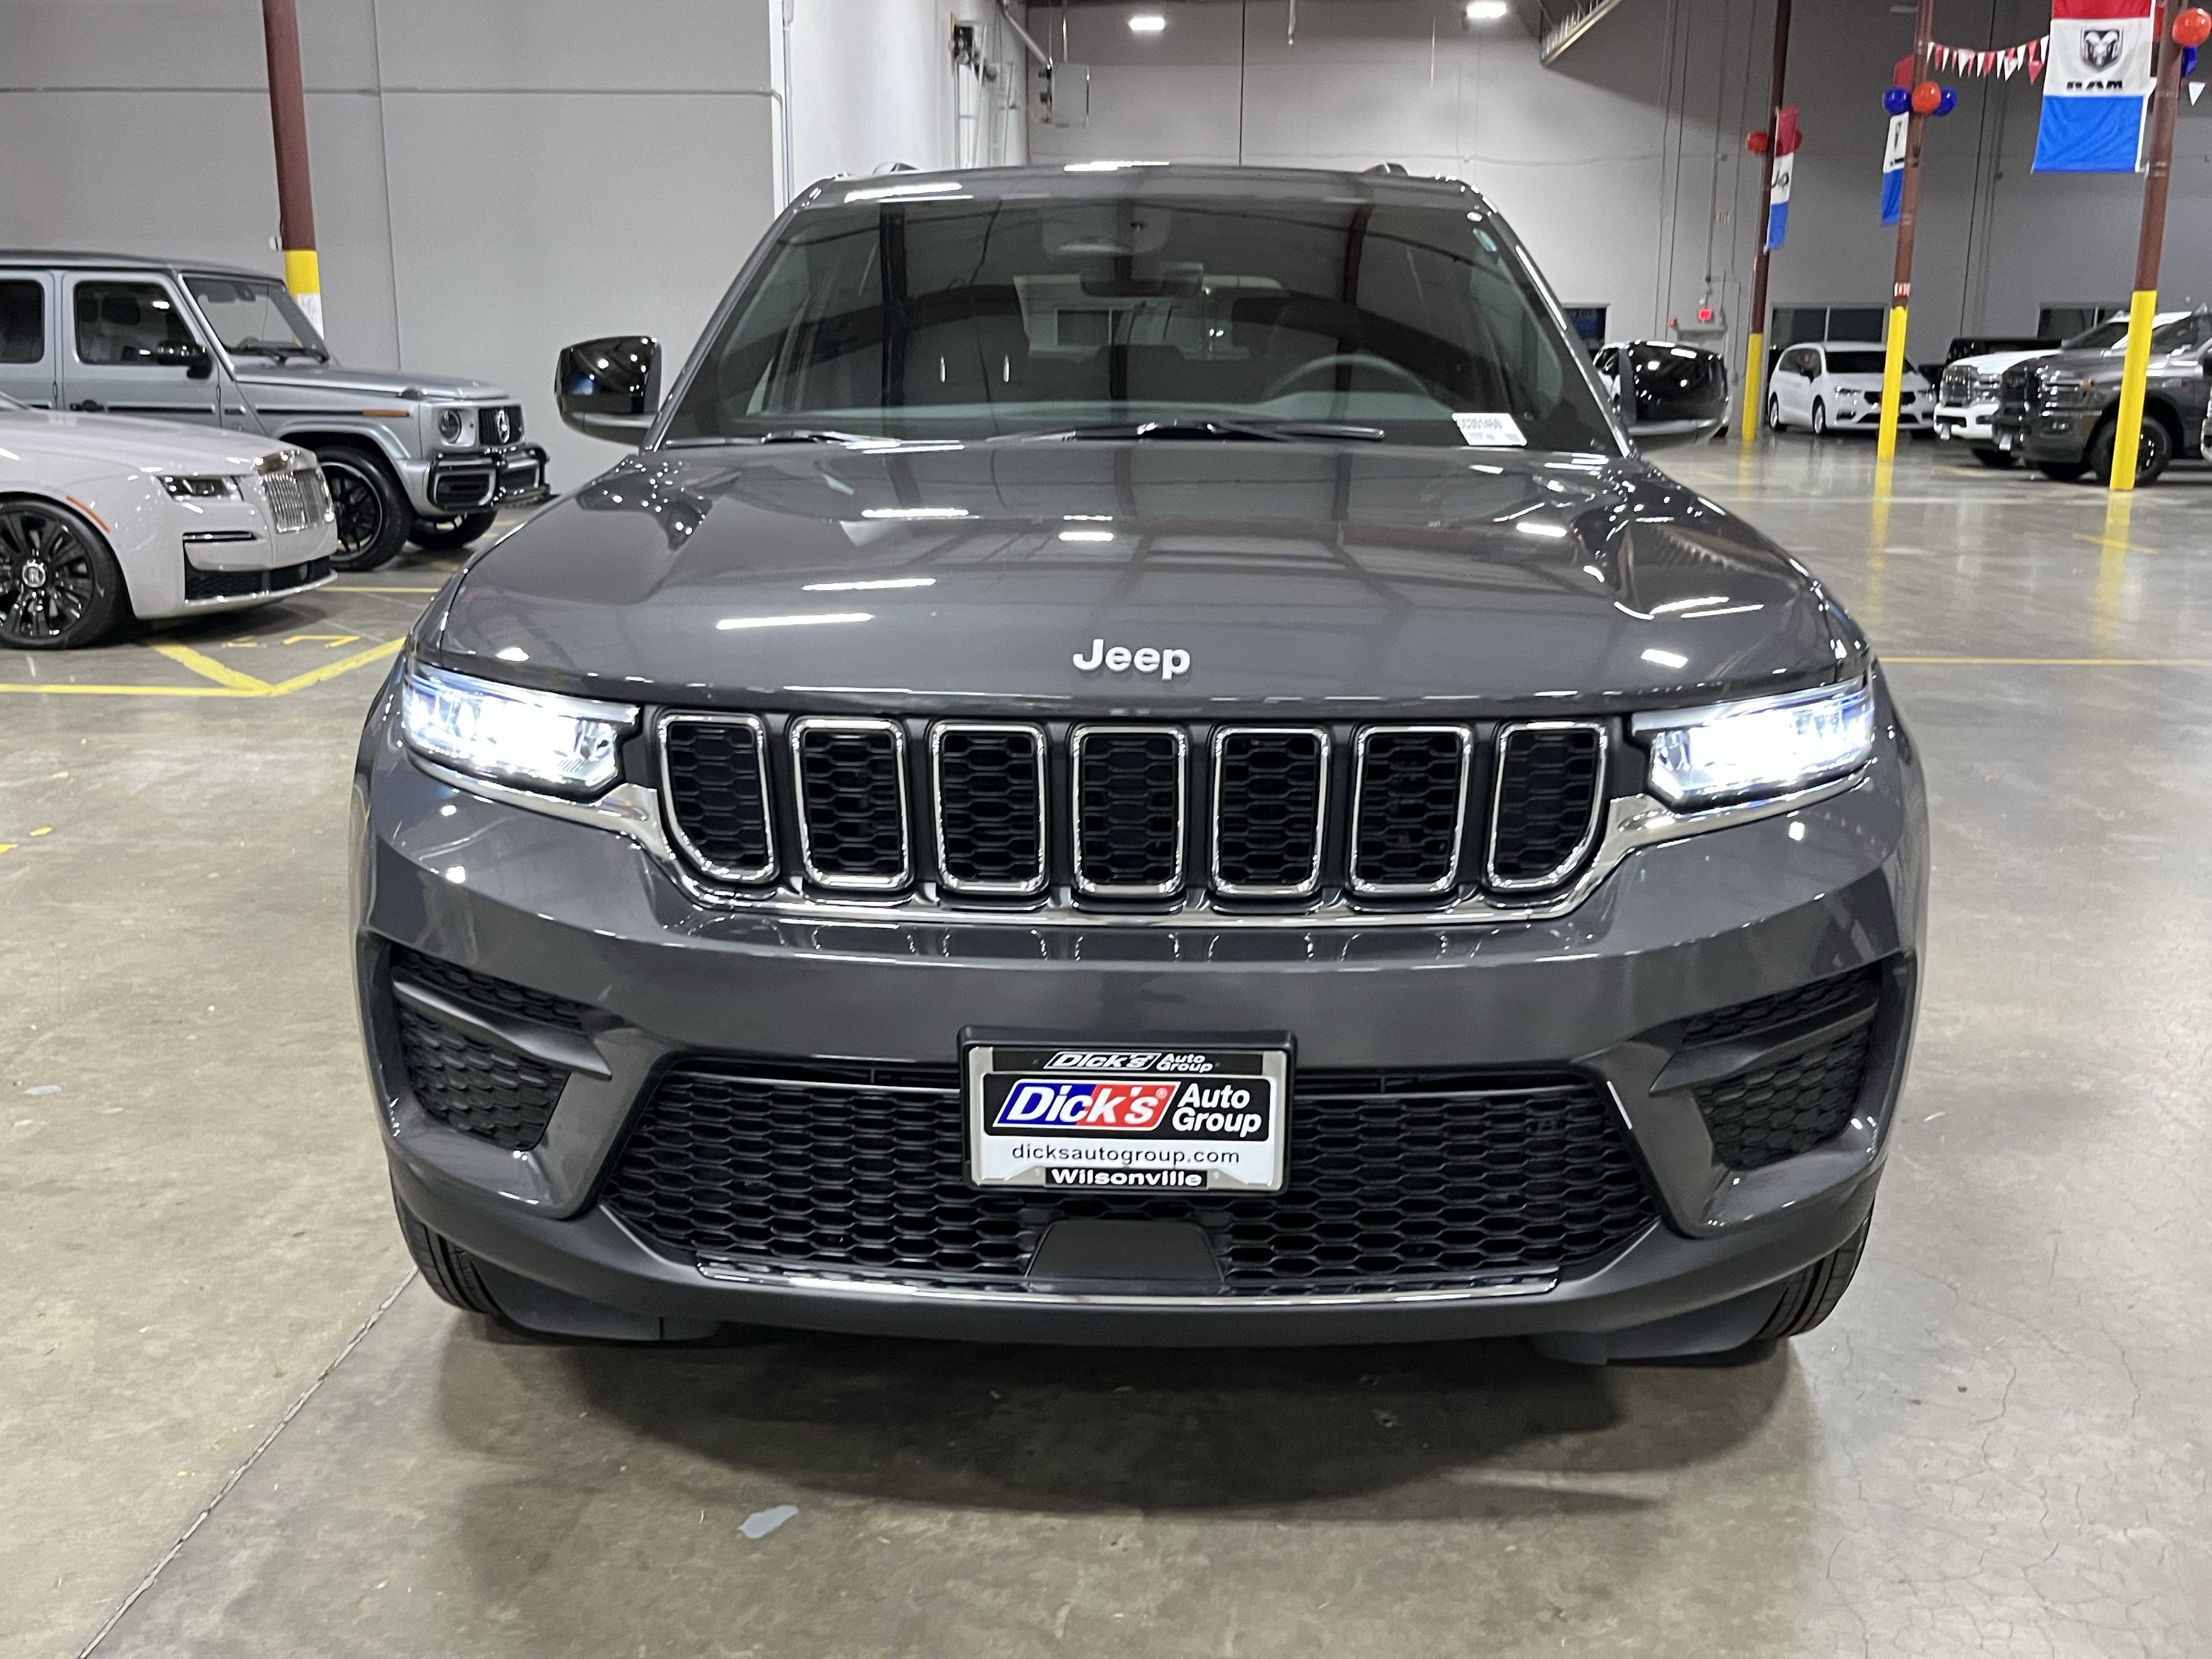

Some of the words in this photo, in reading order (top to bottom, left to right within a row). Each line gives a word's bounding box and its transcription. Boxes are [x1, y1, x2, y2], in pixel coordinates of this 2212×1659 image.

[1073, 639, 1190, 680] Jeep
[1051, 1052, 1153, 1069] Dick's
[1163, 1053, 1205, 1063] Auto
[1156, 1062, 1213, 1073] Group
[1007, 1085, 1159, 1124] Dick's
[1177, 1083, 1250, 1109] Auto
[1172, 1111, 1261, 1137] Group
[1012, 1144, 1239, 1165] dicksautogroup.com
[1051, 1169, 1203, 1187] Wilsonville
